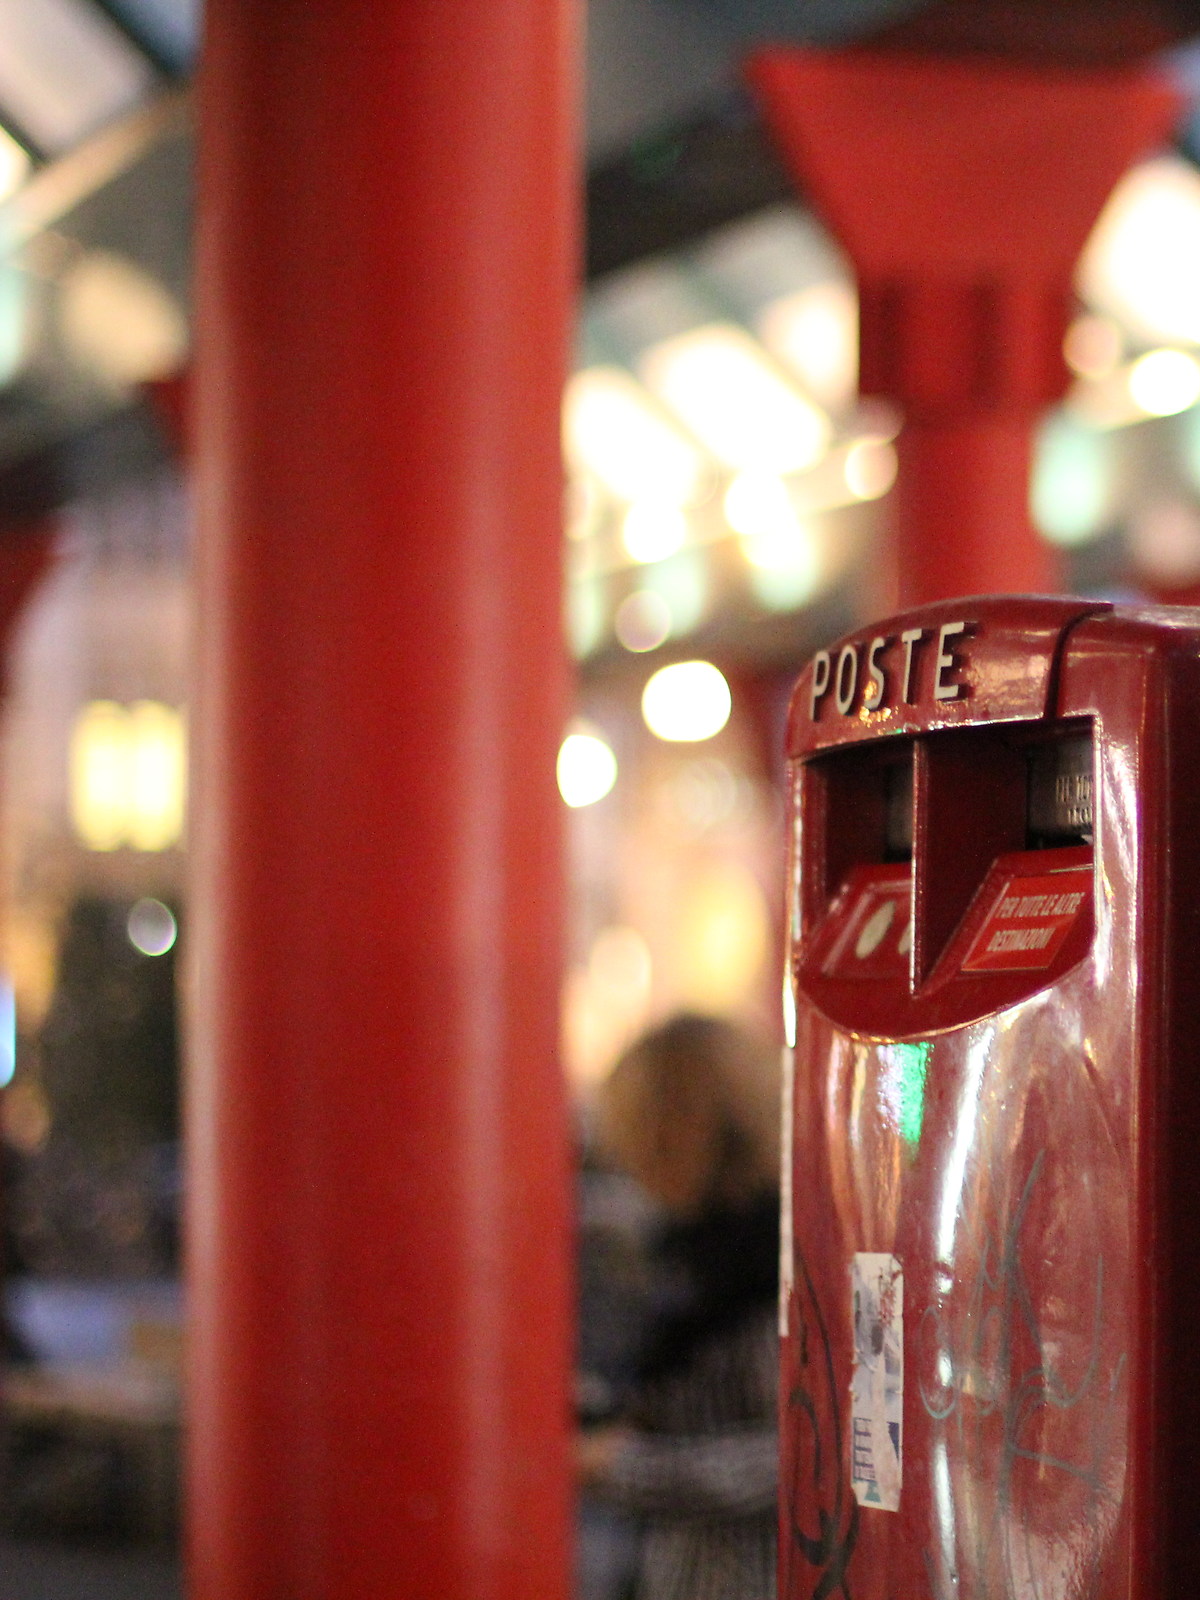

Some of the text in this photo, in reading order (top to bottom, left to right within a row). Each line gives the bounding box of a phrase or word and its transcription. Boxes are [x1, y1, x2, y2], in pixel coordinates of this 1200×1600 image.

[809, 621, 965, 721] POSTE
[995, 897, 1020, 918] PER
[1040, 894, 1059, 916] LE
